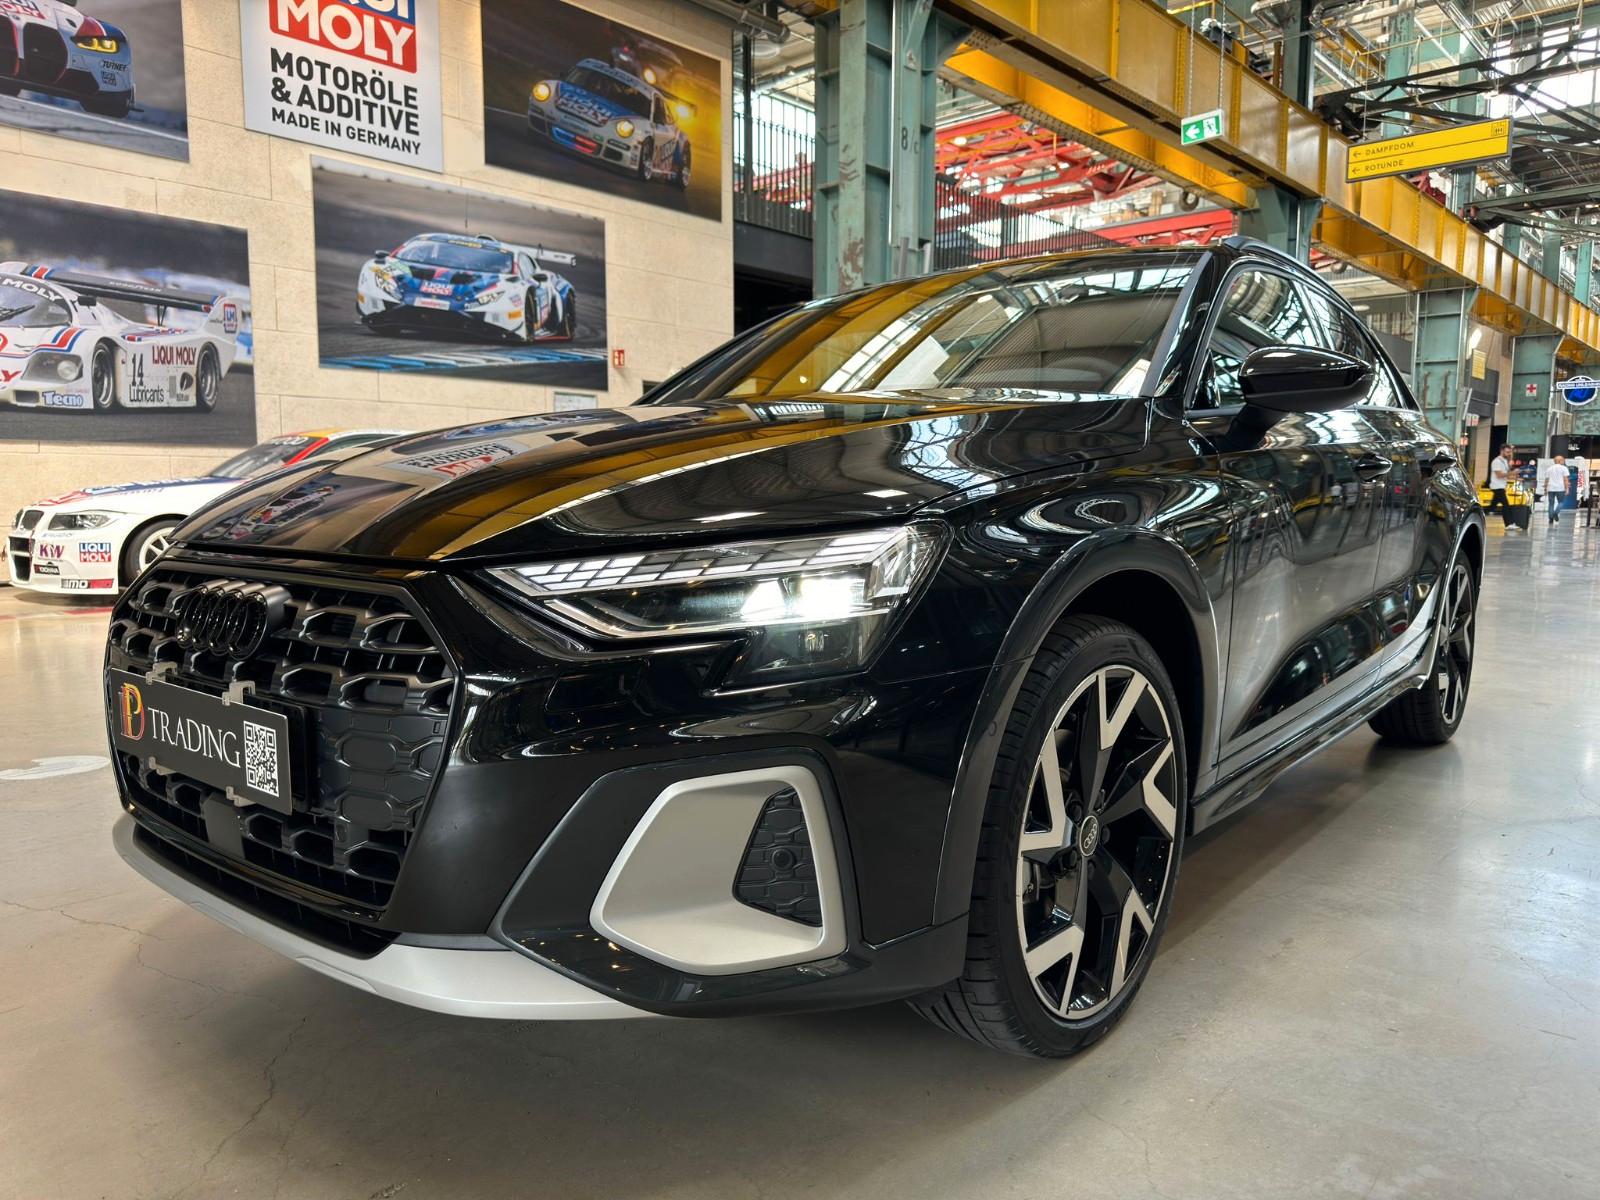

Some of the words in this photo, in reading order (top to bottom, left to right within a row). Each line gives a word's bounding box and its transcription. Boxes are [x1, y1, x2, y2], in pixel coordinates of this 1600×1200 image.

[277, 0, 414, 66] MOLY
[270, 47, 418, 110] MOTORÖLE
[271, 77, 292, 104] &
[297, 84, 420, 136] ADDITIVE
[272, 107, 320, 132] MADE
[325, 120, 341, 137] IN
[346, 126, 421, 155] GERMANY
[1365, 141, 1414, 156] DAMPFDOM
[1364, 160, 1404, 172] ROTUNDE
[2, 278, 62, 302] MOLY
[176, 346, 197, 365] MOLY
[131, 353, 144, 386] 14
[129, 384, 165, 402] Lubricants
[39, 544, 65, 558] KW
[80, 543, 110, 553] LIQUI
[80, 552, 111, 562] MOLY
[147, 706, 242, 769] TRADING
